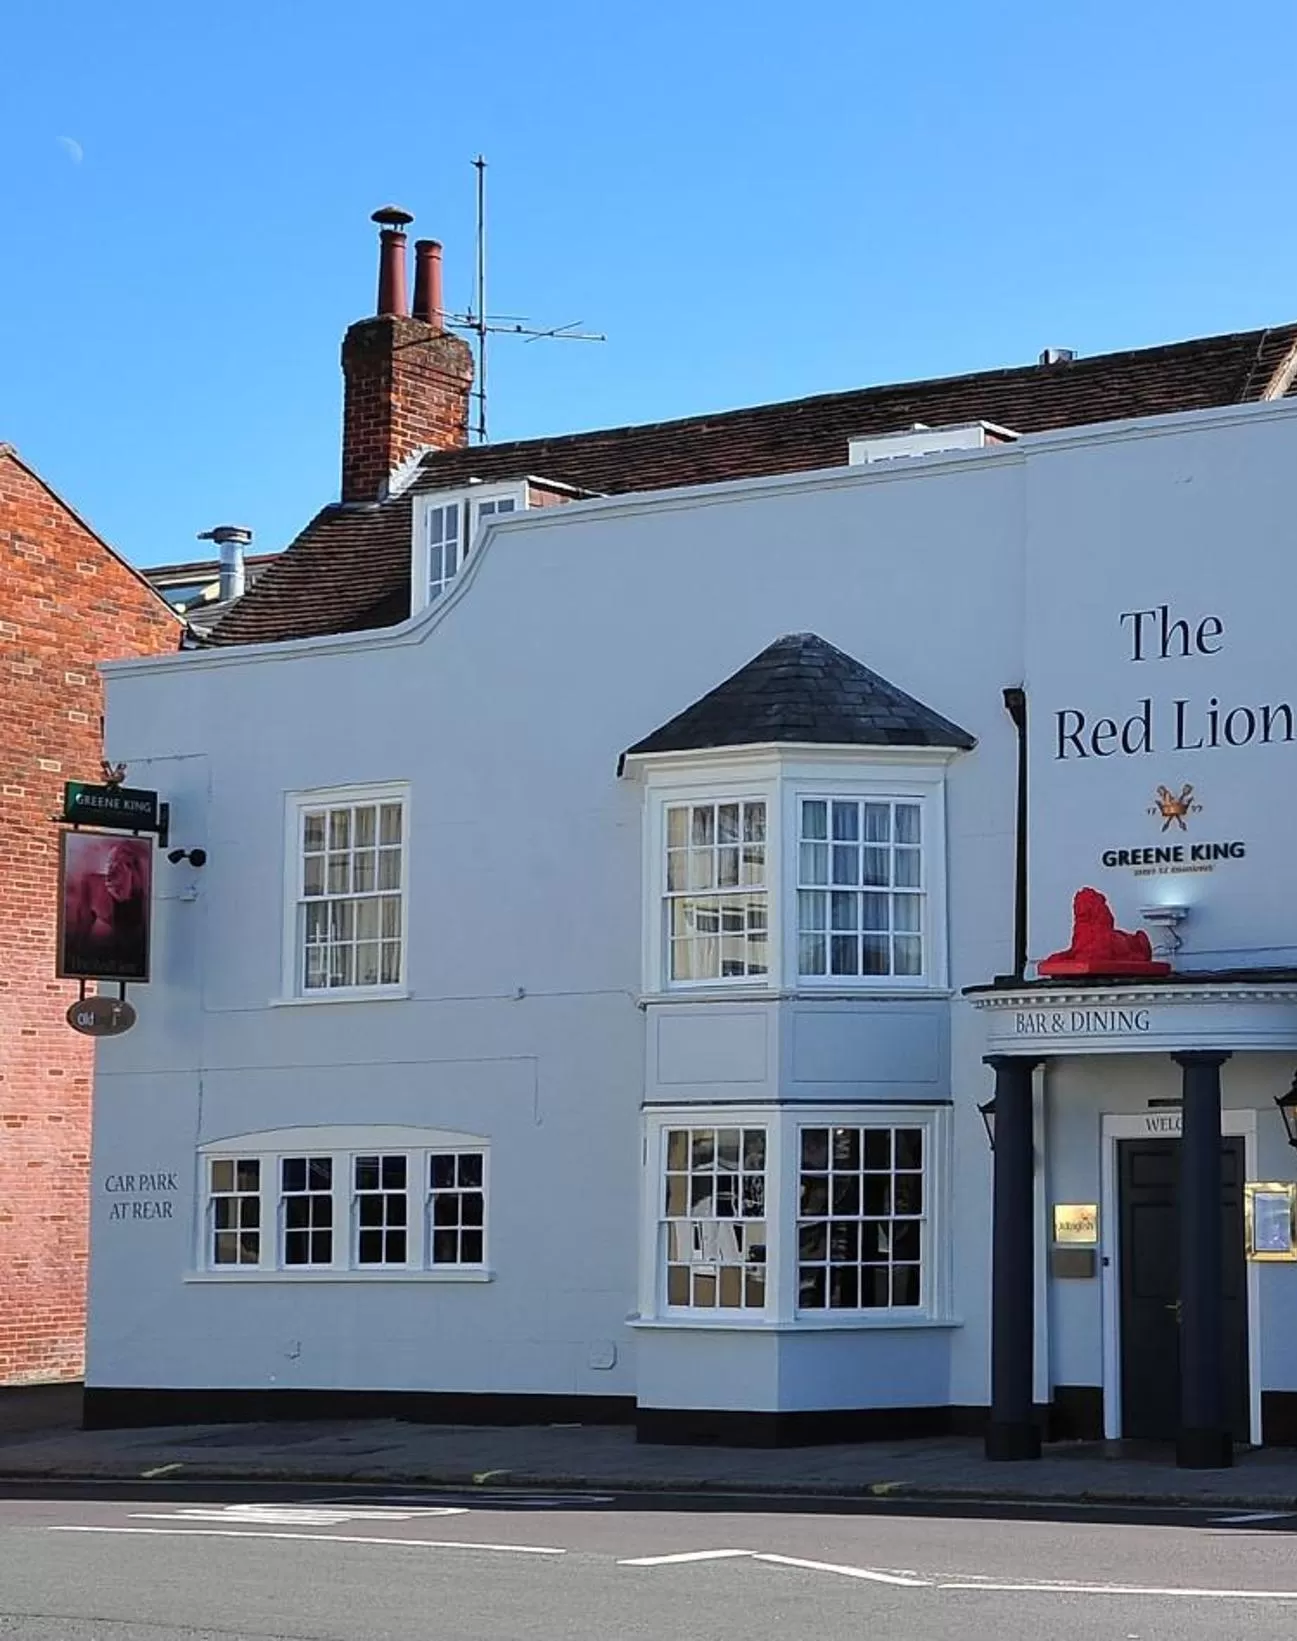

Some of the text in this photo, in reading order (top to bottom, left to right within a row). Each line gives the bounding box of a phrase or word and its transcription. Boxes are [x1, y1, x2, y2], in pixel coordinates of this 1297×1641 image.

[1119, 604, 1224, 662] The
[1053, 697, 1297, 761] Red Lion
[75, 793, 121, 809] GREENE
[123, 799, 152, 813] KING
[1101, 841, 1246, 868] GREENE KING
[1015, 1009, 1150, 1034] BAR & DINING
[1145, 1117, 1183, 1133] WELC
[105, 1173, 178, 1192] CAR PARK
[109, 1201, 173, 1219] AT REAR
